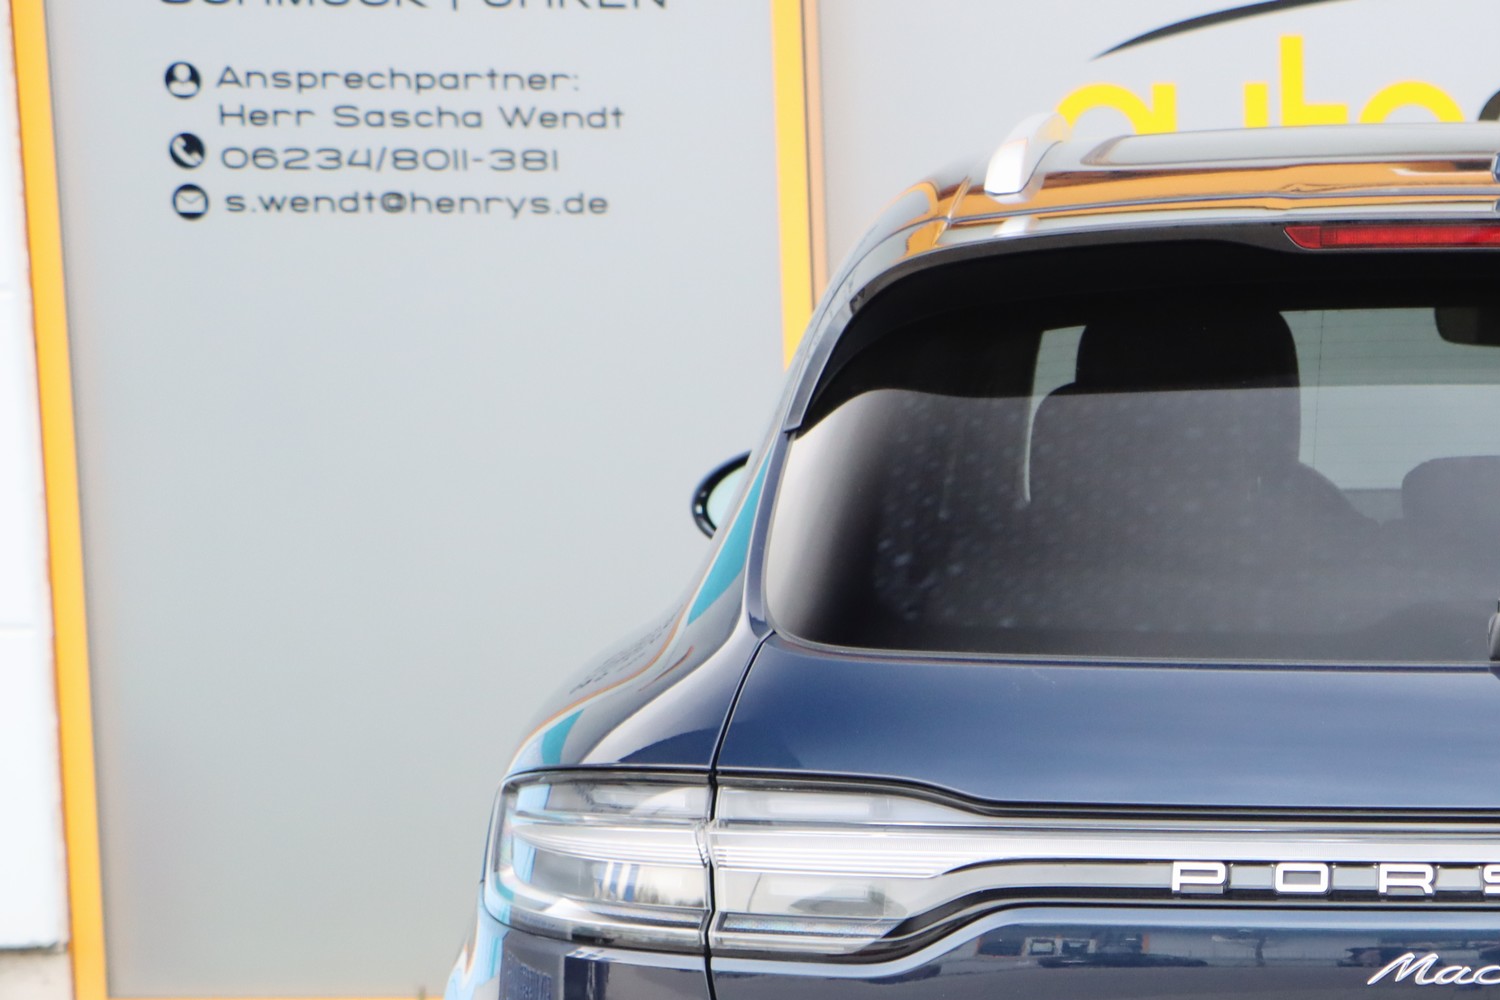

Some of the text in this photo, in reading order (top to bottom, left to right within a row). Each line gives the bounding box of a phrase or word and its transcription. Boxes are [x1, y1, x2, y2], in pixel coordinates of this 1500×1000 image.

[215, 65, 580, 95] Ansprechpartner:
[217, 103, 625, 130] Herr Sascha Wendt
[220, 145, 559, 172] 06234/8011-381
[224, 190, 609, 219] s.wendt@henrys.de
